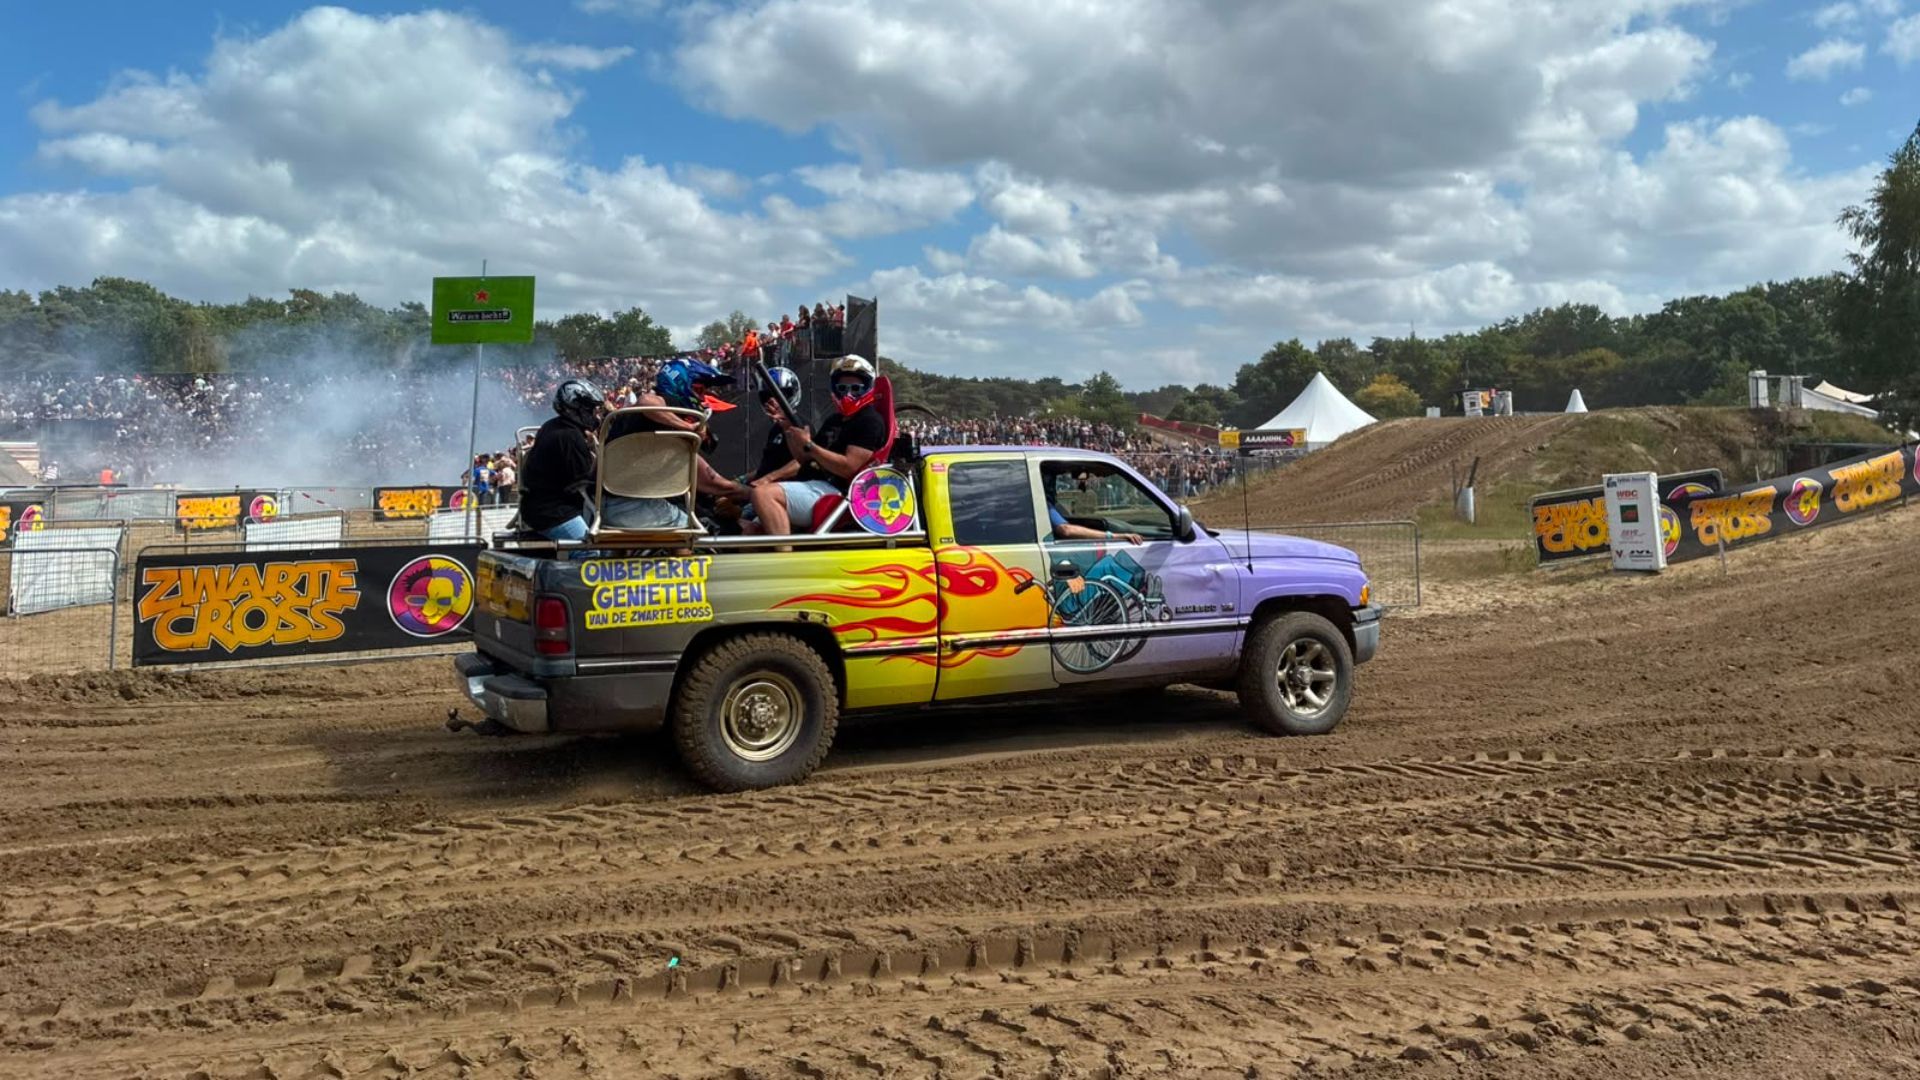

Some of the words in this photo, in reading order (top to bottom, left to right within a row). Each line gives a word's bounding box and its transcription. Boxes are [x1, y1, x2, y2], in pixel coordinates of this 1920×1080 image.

[1828, 450, 1905, 497] ZWARTE
[1688, 485, 1777, 530] ZWARTE
[1835, 479, 1902, 513] CROSS
[1534, 496, 1608, 535] ZWAR
[1698, 513, 1772, 546] CROSS
[1542, 518, 1611, 553] CRO
[585, 558, 708, 582] ONBEPERKT
[138, 558, 362, 623] ZWARTE
[596, 582, 703, 609] GENIETEN
[153, 597, 346, 653] CROSS
[589, 613, 609, 625] VAN
[612, 612, 626, 623] DE
[630, 609, 673, 622] ZWARTE
[676, 606, 711, 619] CROSS
